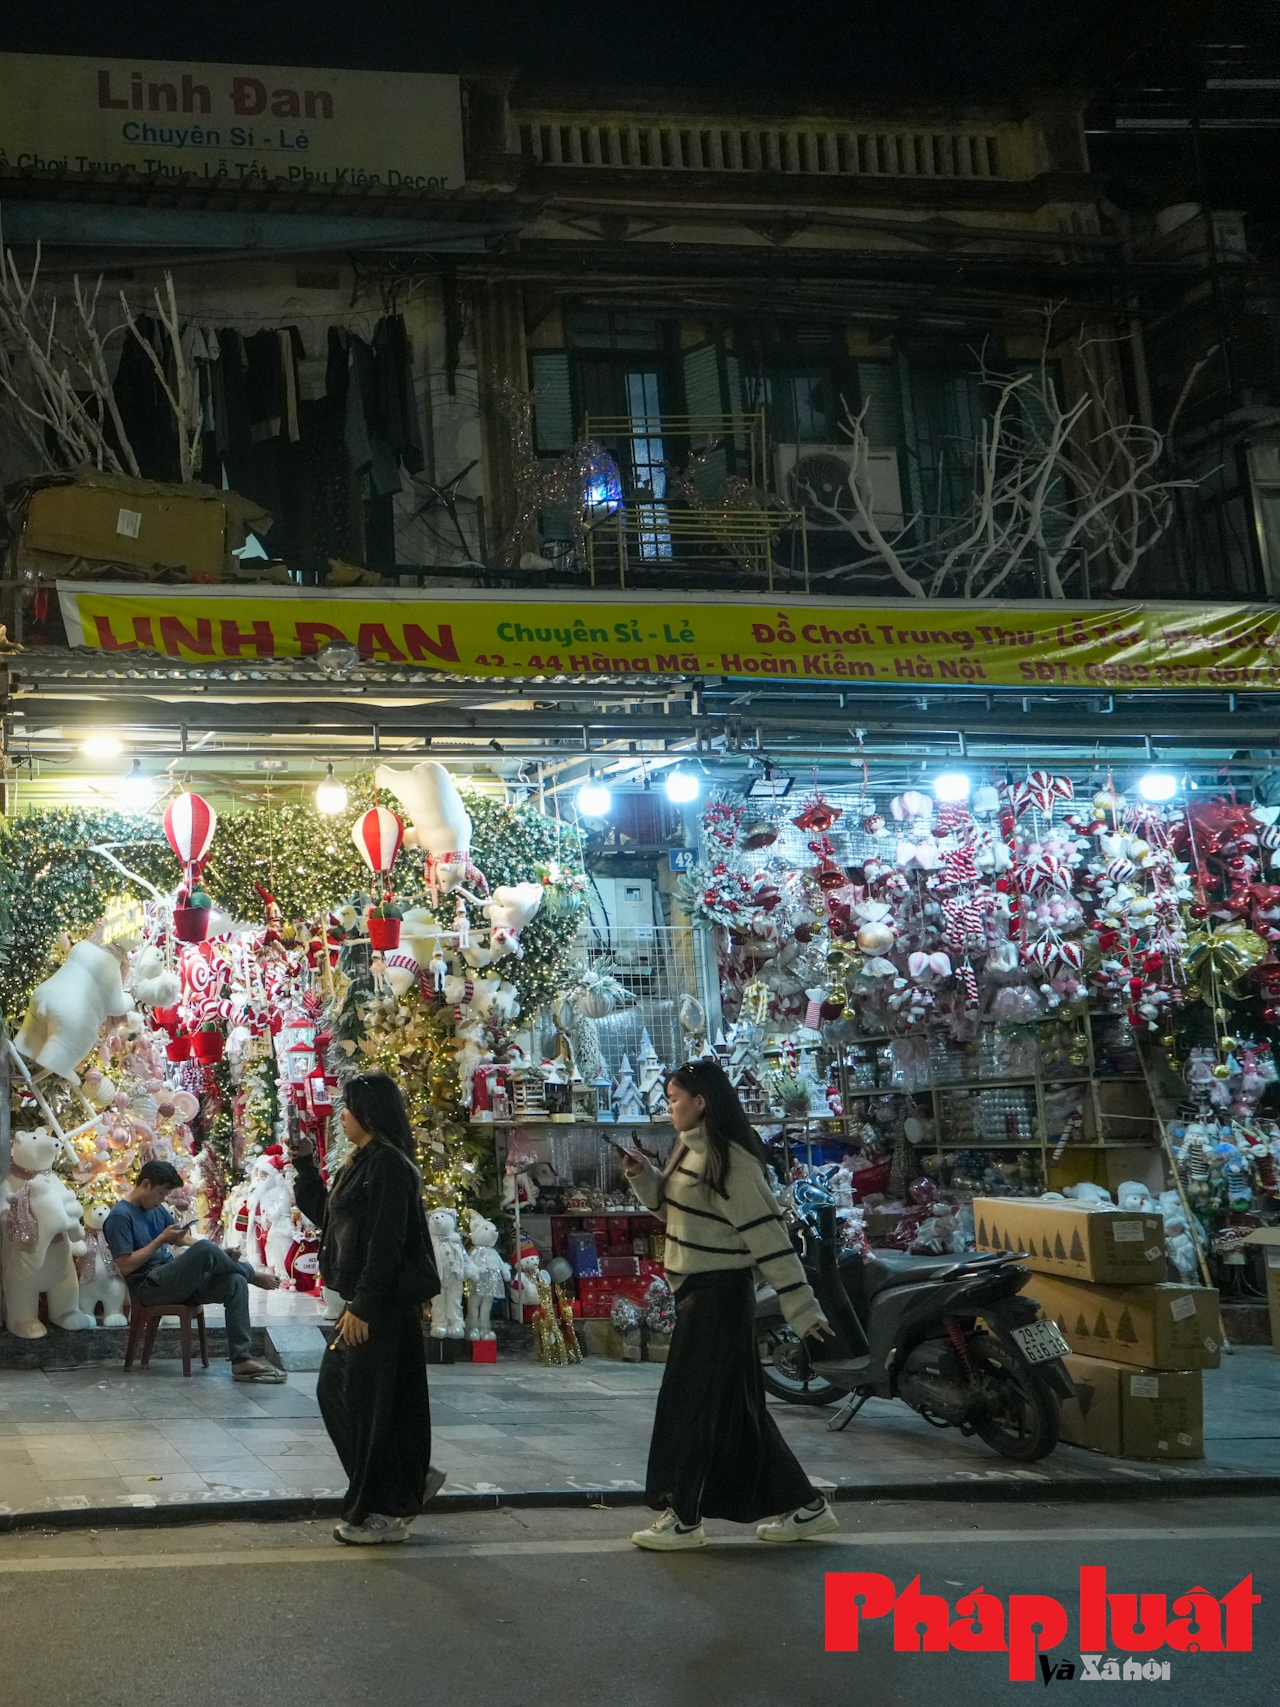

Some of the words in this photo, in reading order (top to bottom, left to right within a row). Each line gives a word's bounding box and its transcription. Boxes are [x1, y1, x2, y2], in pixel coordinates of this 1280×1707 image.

[97, 70, 212, 114] Linh
[230, 77, 334, 119] Đan
[122, 122, 220, 149] Chuyên
[230, 125, 254, 147] Sỉ
[280, 128, 310, 149] Lẻ
[389, 170, 448, 189] Decor
[93, 615, 274, 656] LINH
[497, 620, 609, 647] Chuyên
[614, 620, 643, 643] Sỉ
[663, 620, 694, 643] Lẻ
[751, 613, 796, 644] Đồ
[801, 623, 873, 645] Chơi
[877, 625, 974, 650] Trung
[975, 626, 1035, 647] Thu
[1056, 617, 1089, 647] Lễ
[474, 654, 508, 667] 42
[528, 655, 563, 671] 44
[655, 651, 702, 674] Mã
[720, 652, 798, 676] Hoàn
[894, 654, 934, 678] Hà
[938, 657, 987, 684] Nội
[1019, 661, 1079, 681] SĐT:
[1155, 664, 1200, 682] 097
[675, 852, 694, 868] 42
[1025, 1338, 1067, 1361] 636.38
